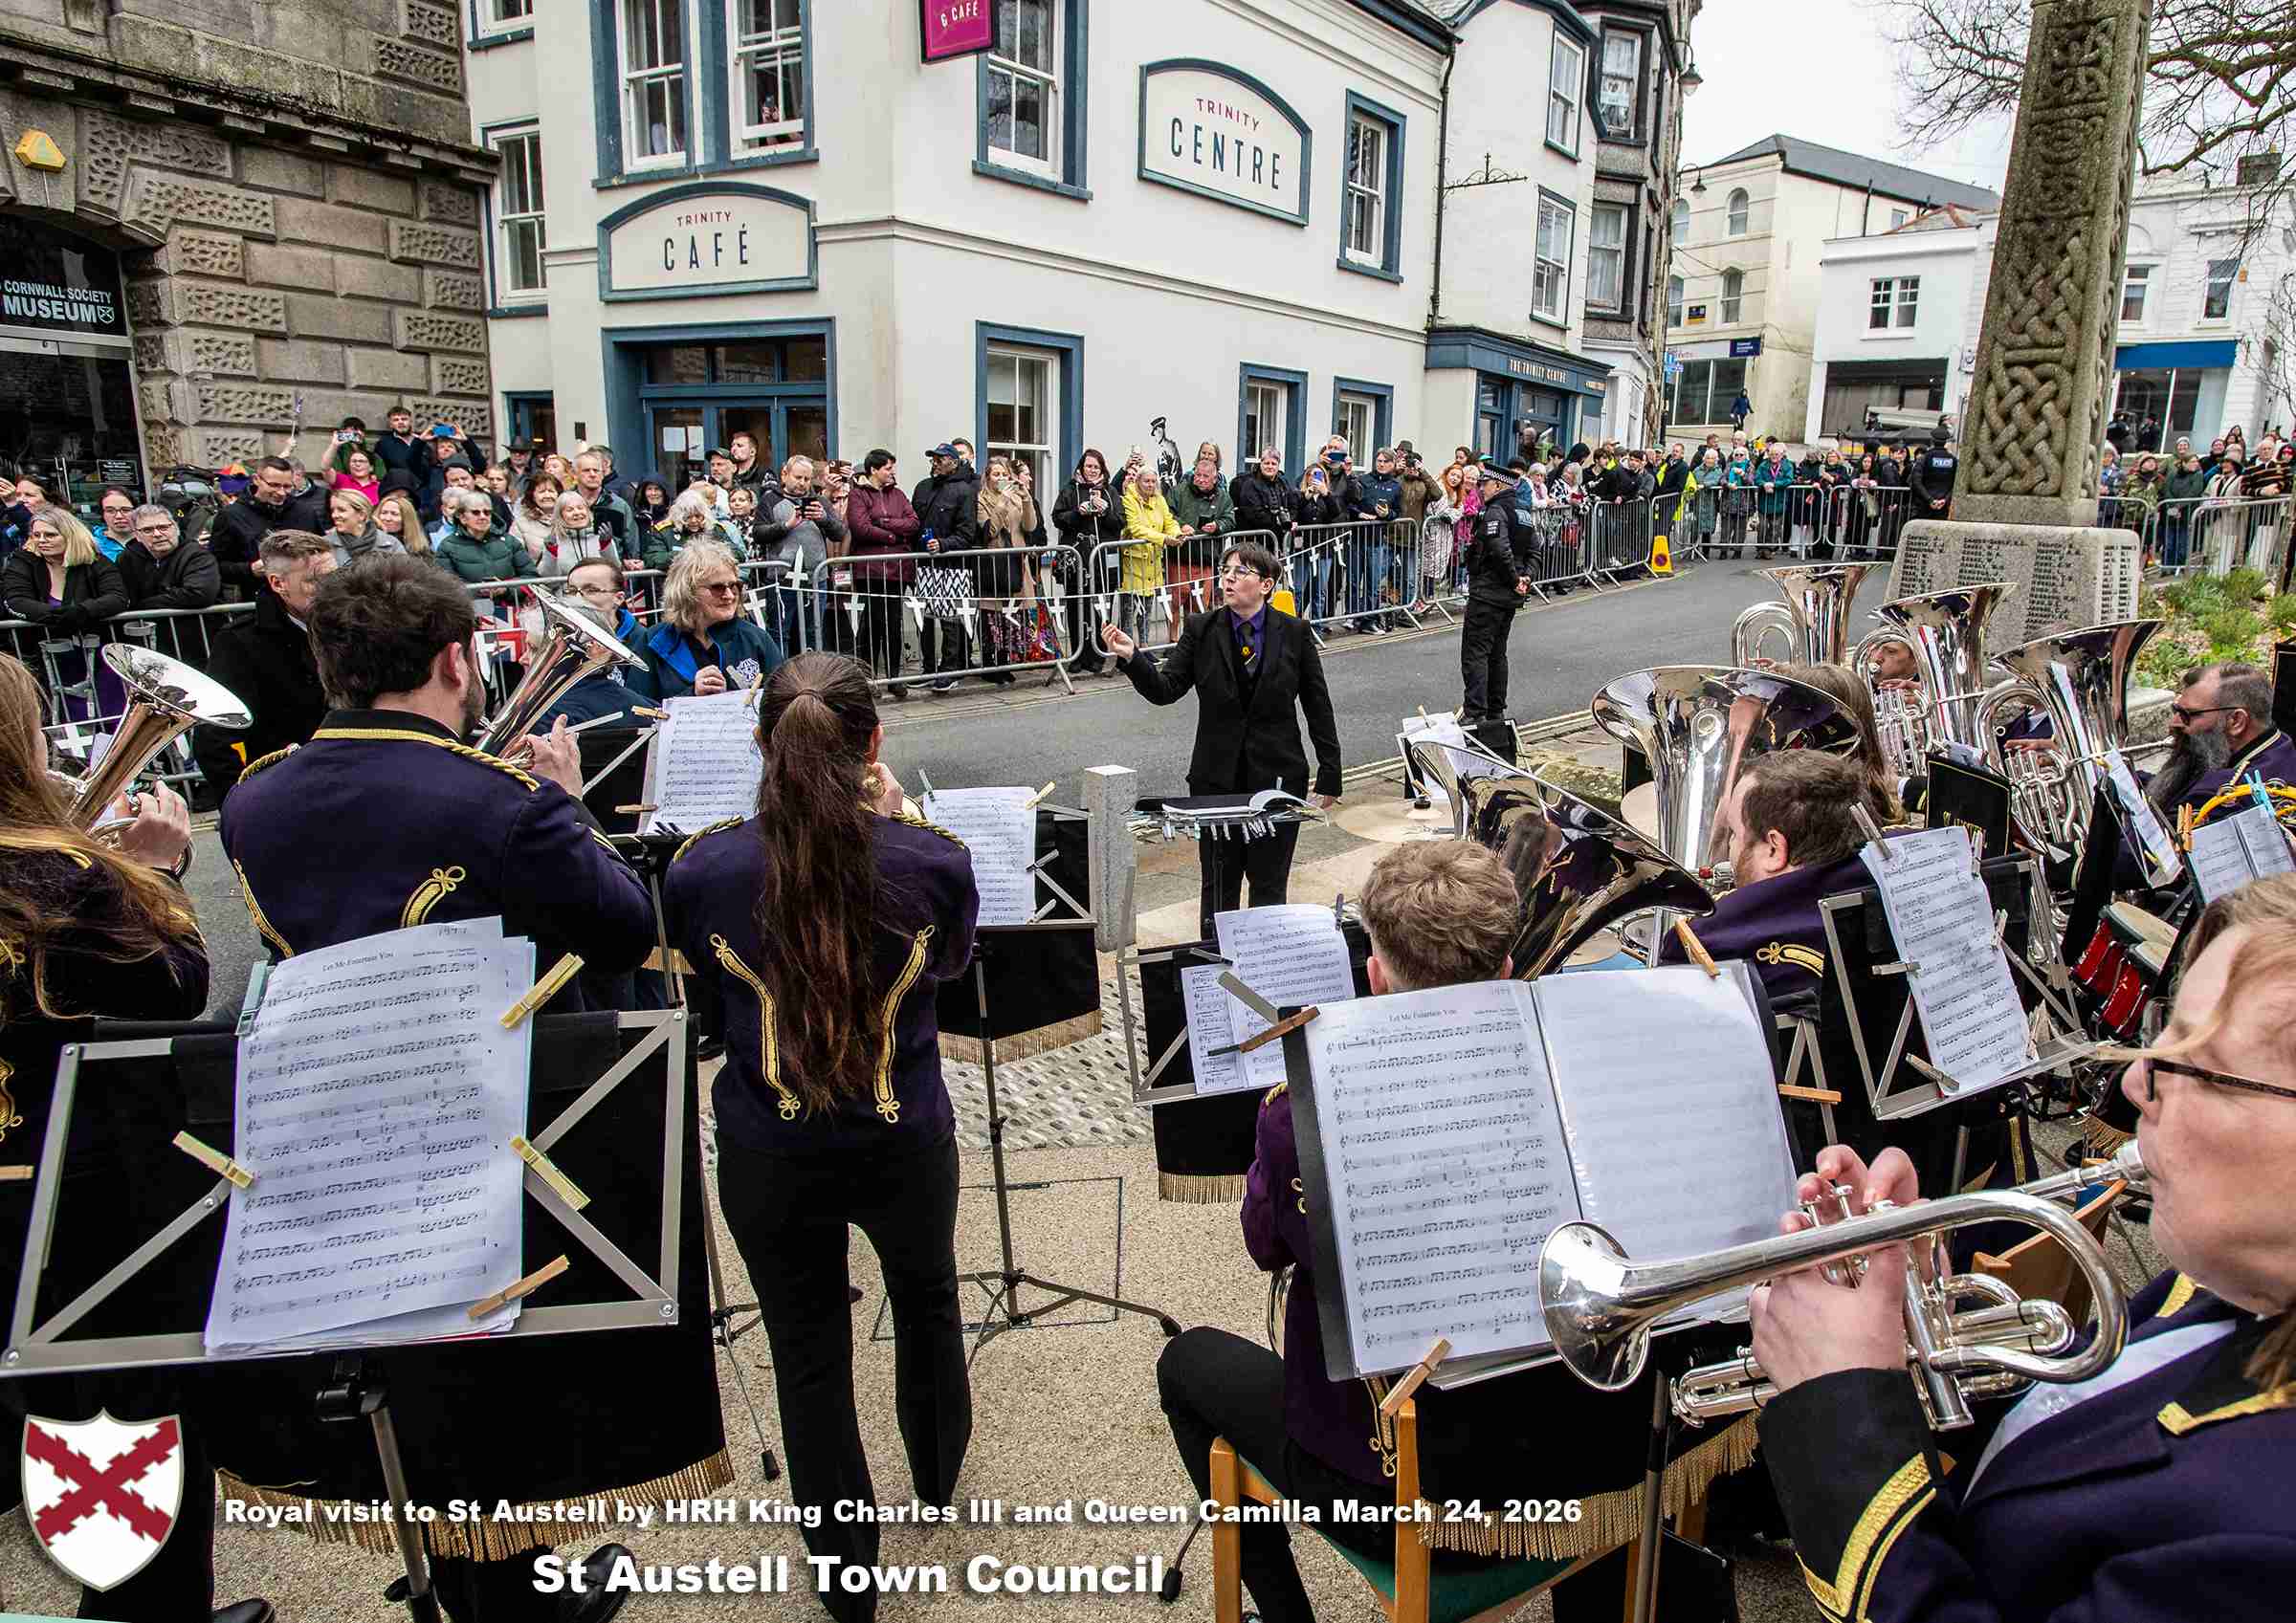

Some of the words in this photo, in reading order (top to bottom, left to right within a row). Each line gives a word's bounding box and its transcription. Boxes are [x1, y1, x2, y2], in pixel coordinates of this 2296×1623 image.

[951, 0, 979, 21] CAFÉ
[1196, 98, 1262, 132] TRINITY
[1170, 117, 1281, 191] CENTRE
[676, 210, 733, 227] TRINITY
[663, 223, 750, 273] CAFÉ
[4, 280, 66, 299] CORNWALL
[67, 287, 112, 304] SOCIETY
[3, 295, 98, 323] MUSEUM
